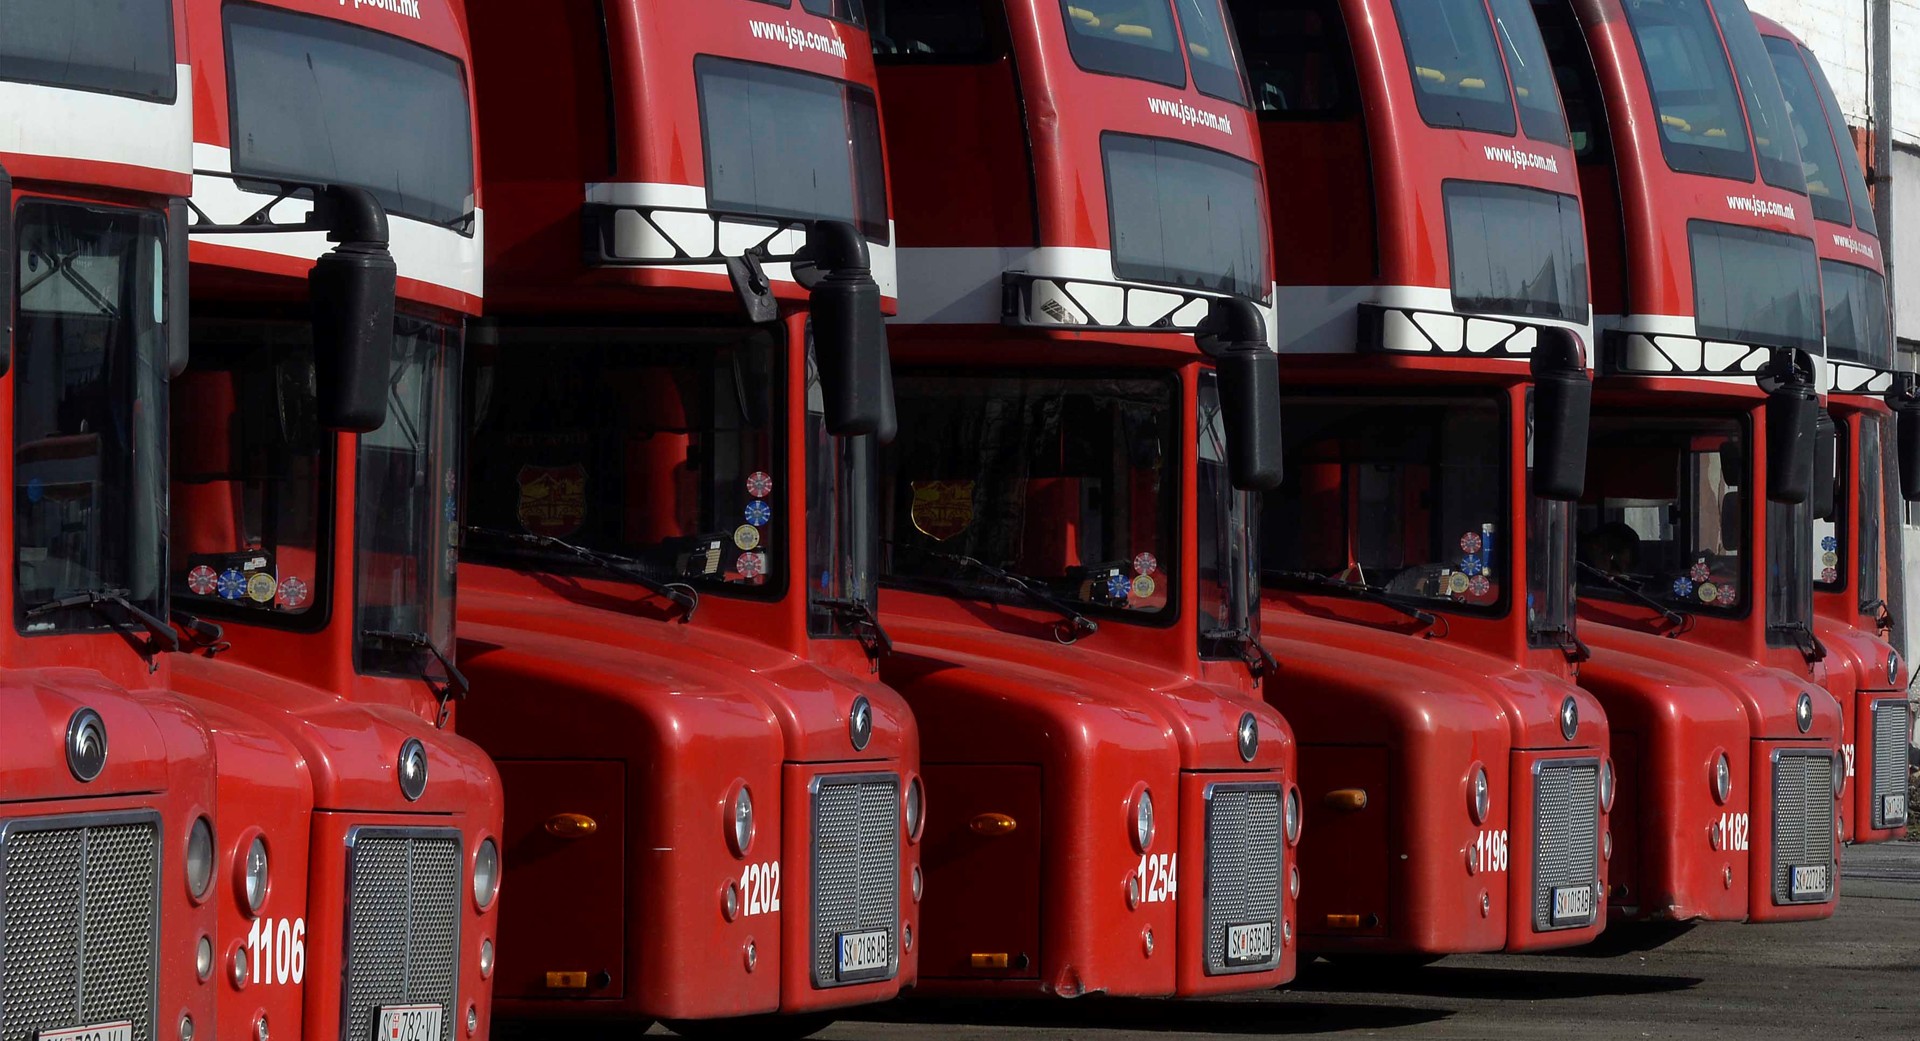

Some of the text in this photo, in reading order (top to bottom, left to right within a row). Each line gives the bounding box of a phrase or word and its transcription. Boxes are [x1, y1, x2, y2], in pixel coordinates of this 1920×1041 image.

[749, 19, 848, 60] www.jsp.com.mk
[1147, 97, 1233, 136] www.jsp.com.mk
[1483, 145, 1559, 174] www.jsp.com.mk
[1726, 194, 1796, 221] www.jsp.com.mk
[1475, 829, 1508, 873] 1196
[1719, 812, 1748, 851] 1182
[739, 860, 780, 917] 1202
[1137, 852, 1177, 903] 1254
[247, 917, 305, 985] 1106
[844, 938, 854, 967] SK
